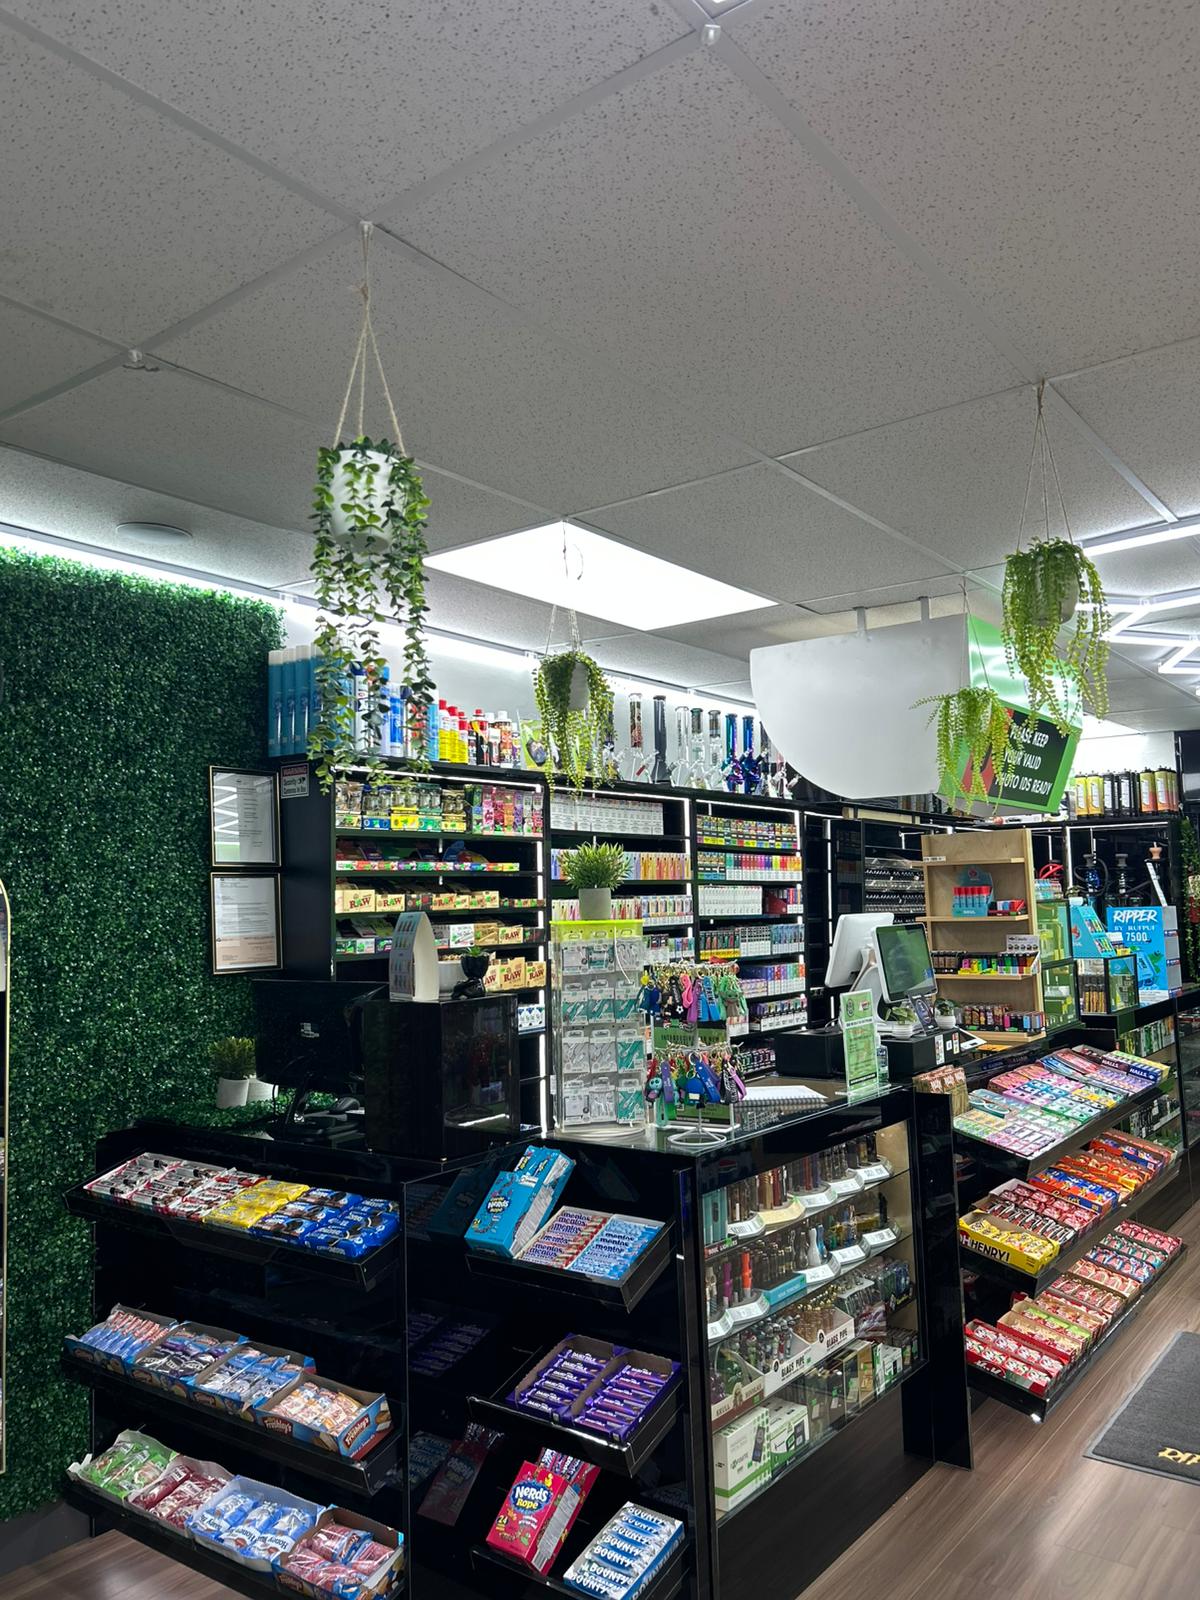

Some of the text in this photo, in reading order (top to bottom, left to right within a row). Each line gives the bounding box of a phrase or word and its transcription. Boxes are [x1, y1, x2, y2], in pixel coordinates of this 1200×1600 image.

[1032, 731, 1049, 748] KEEP
[1023, 753, 1042, 770] VALID
[1019, 776, 1032, 791] IDS
[1031, 779, 1053, 795] READY
[1113, 909, 1158, 923] RIPPER
[505, 930, 520, 941] RAW
[1126, 932, 1148, 942] 7500
[503, 969, 522, 982] RAW
[529, 968, 545, 980] RAW
[1102, 1059, 1119, 1069] HALLS
[1130, 1067, 1147, 1078] HALLS
[971, 1238, 1010, 1262] HENRY!
[516, 1498, 539, 1509] Rope
[611, 1524, 650, 1545] BOUNTY
[270, 1536, 289, 1550] Honey
[604, 1535, 642, 1557] BOUNTY
[593, 1545, 633, 1567] BOUNTY
[590, 1563, 629, 1585] BOUNTY
